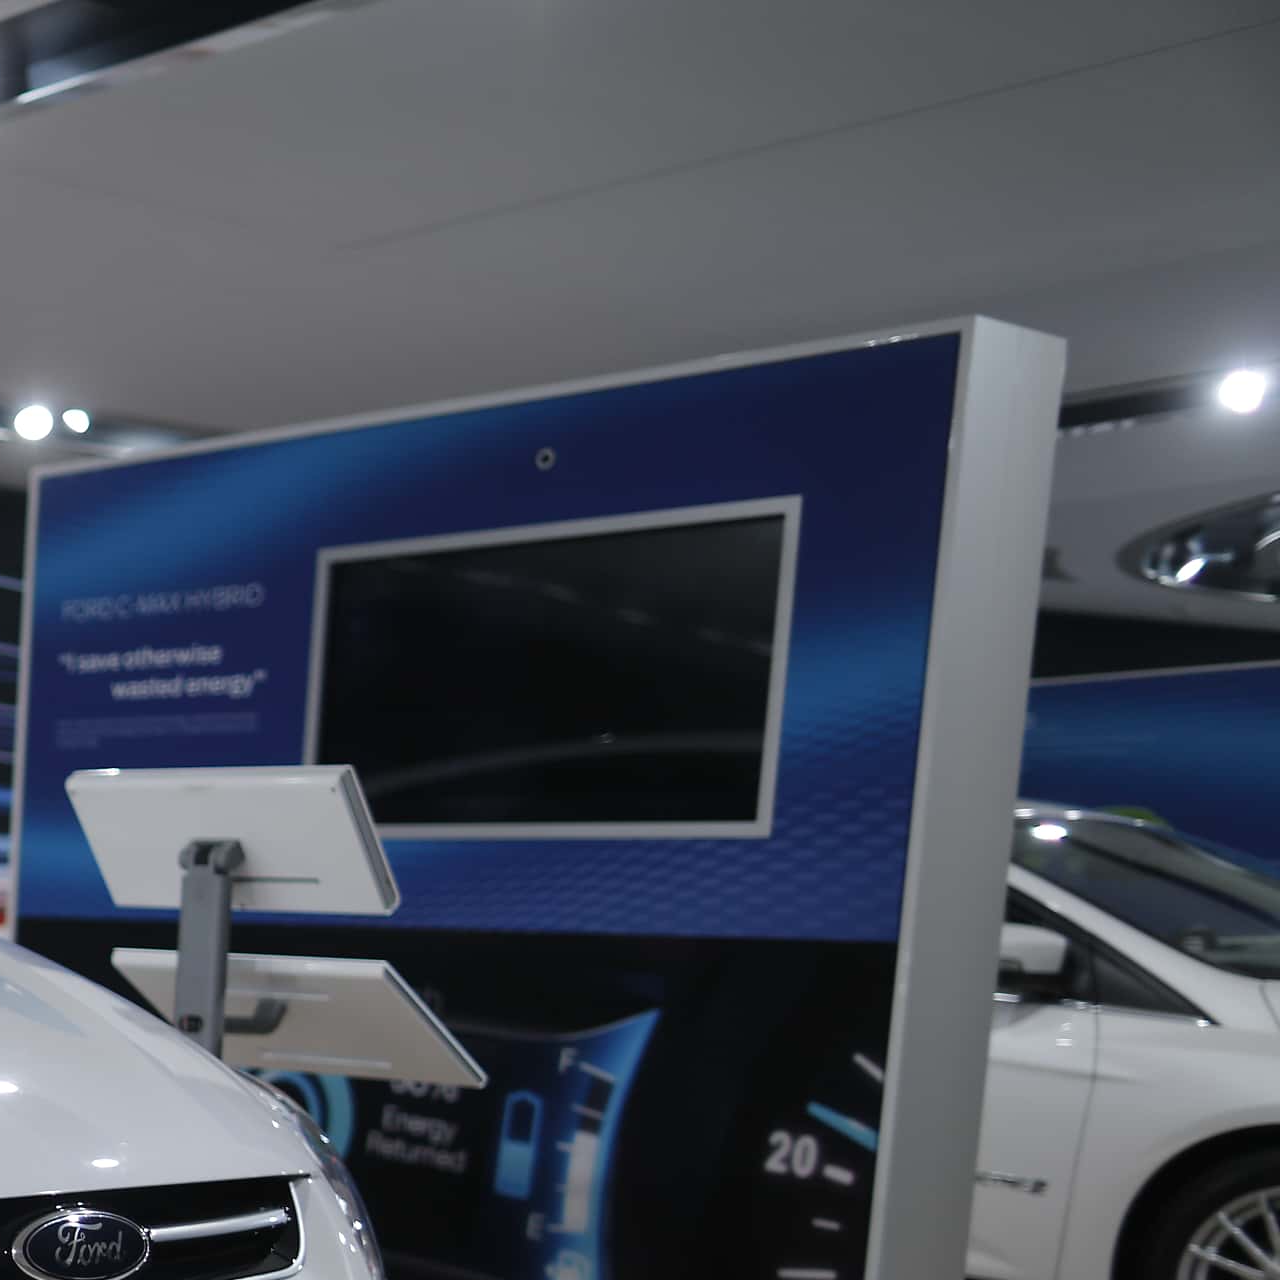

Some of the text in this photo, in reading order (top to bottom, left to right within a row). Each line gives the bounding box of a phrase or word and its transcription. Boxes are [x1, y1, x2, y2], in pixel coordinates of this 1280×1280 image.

[123, 644, 223, 669] otherwise
[111, 675, 183, 698] wasted
[764, 1132, 818, 1179] 20
[55, 1222, 124, 1267] Ford
